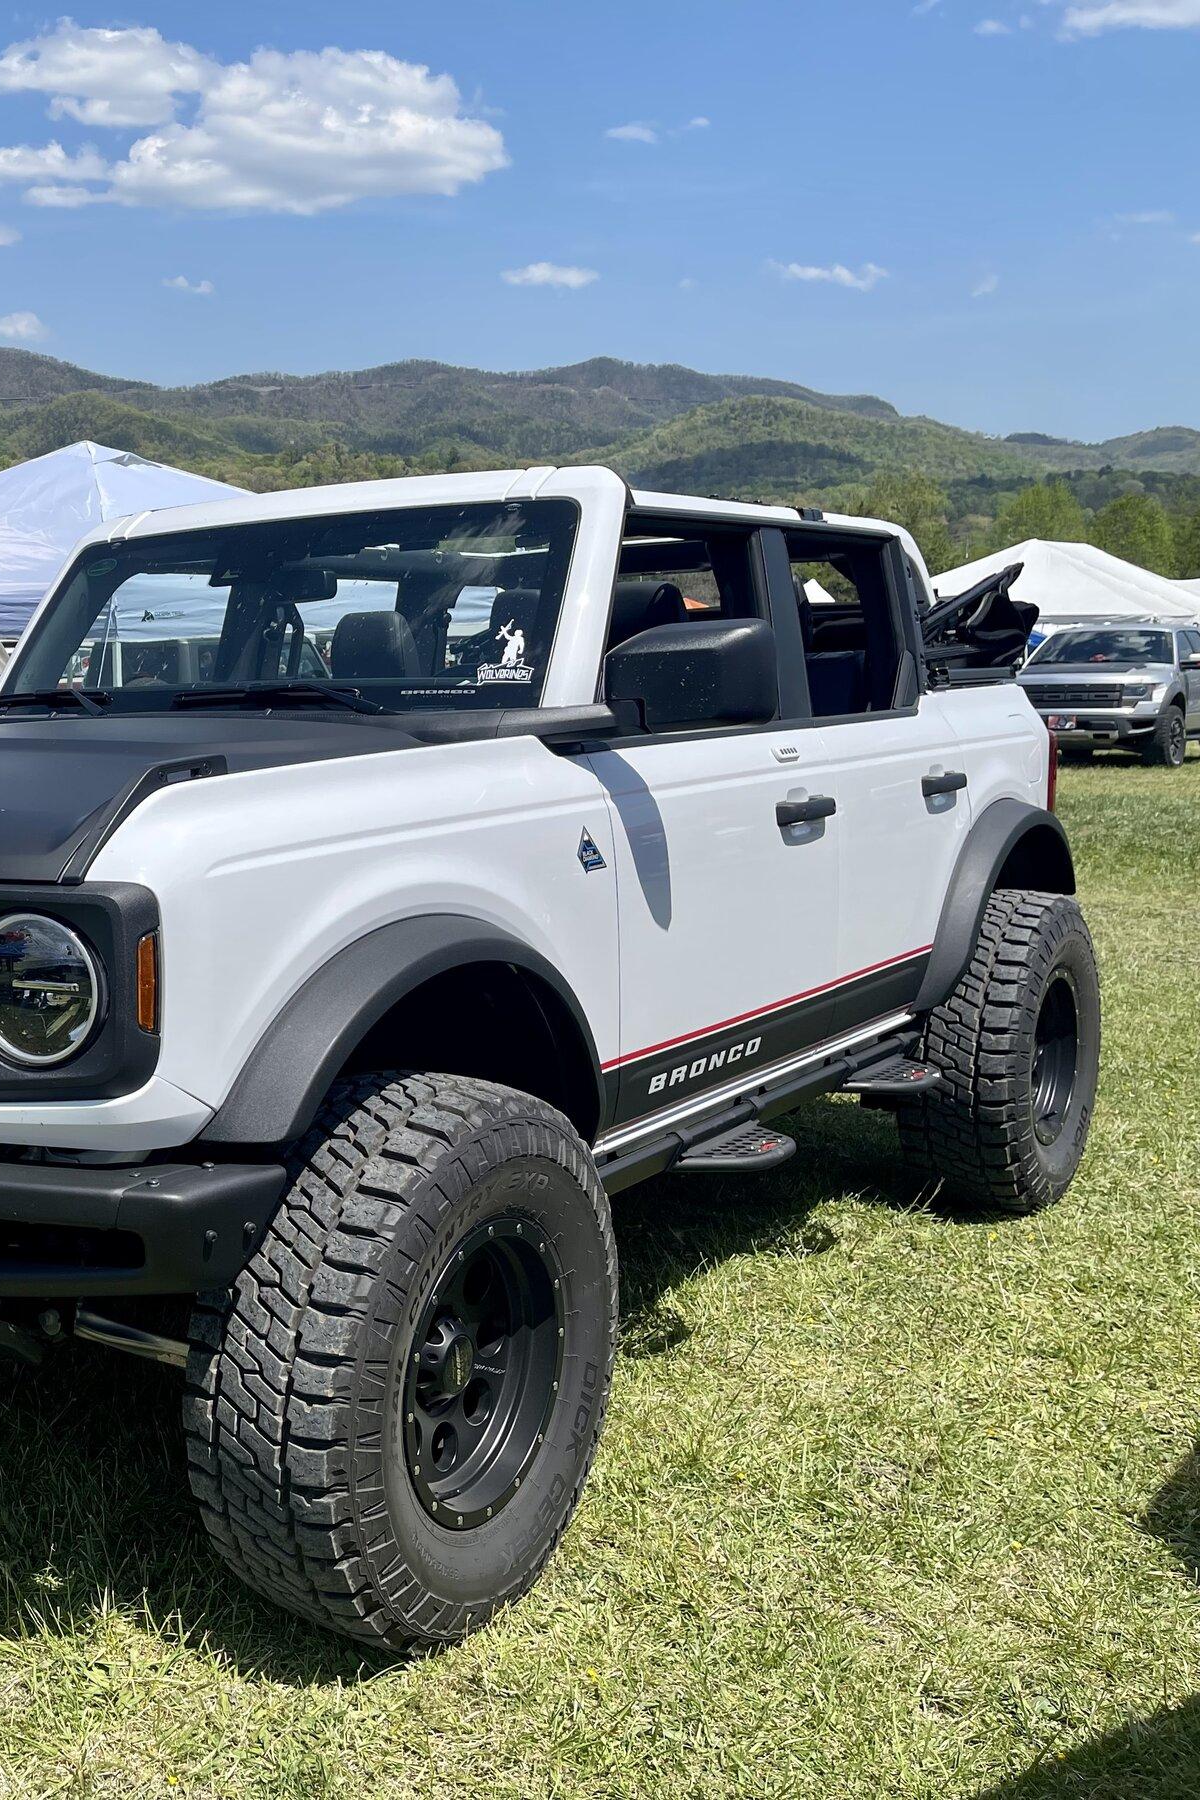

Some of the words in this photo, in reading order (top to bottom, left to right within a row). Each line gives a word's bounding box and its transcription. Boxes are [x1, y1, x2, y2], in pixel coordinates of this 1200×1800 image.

[647, 1036, 762, 1095] BRONCO
[566, 1361, 599, 1462] DICK
[501, 1473, 568, 1576] CEPEK
